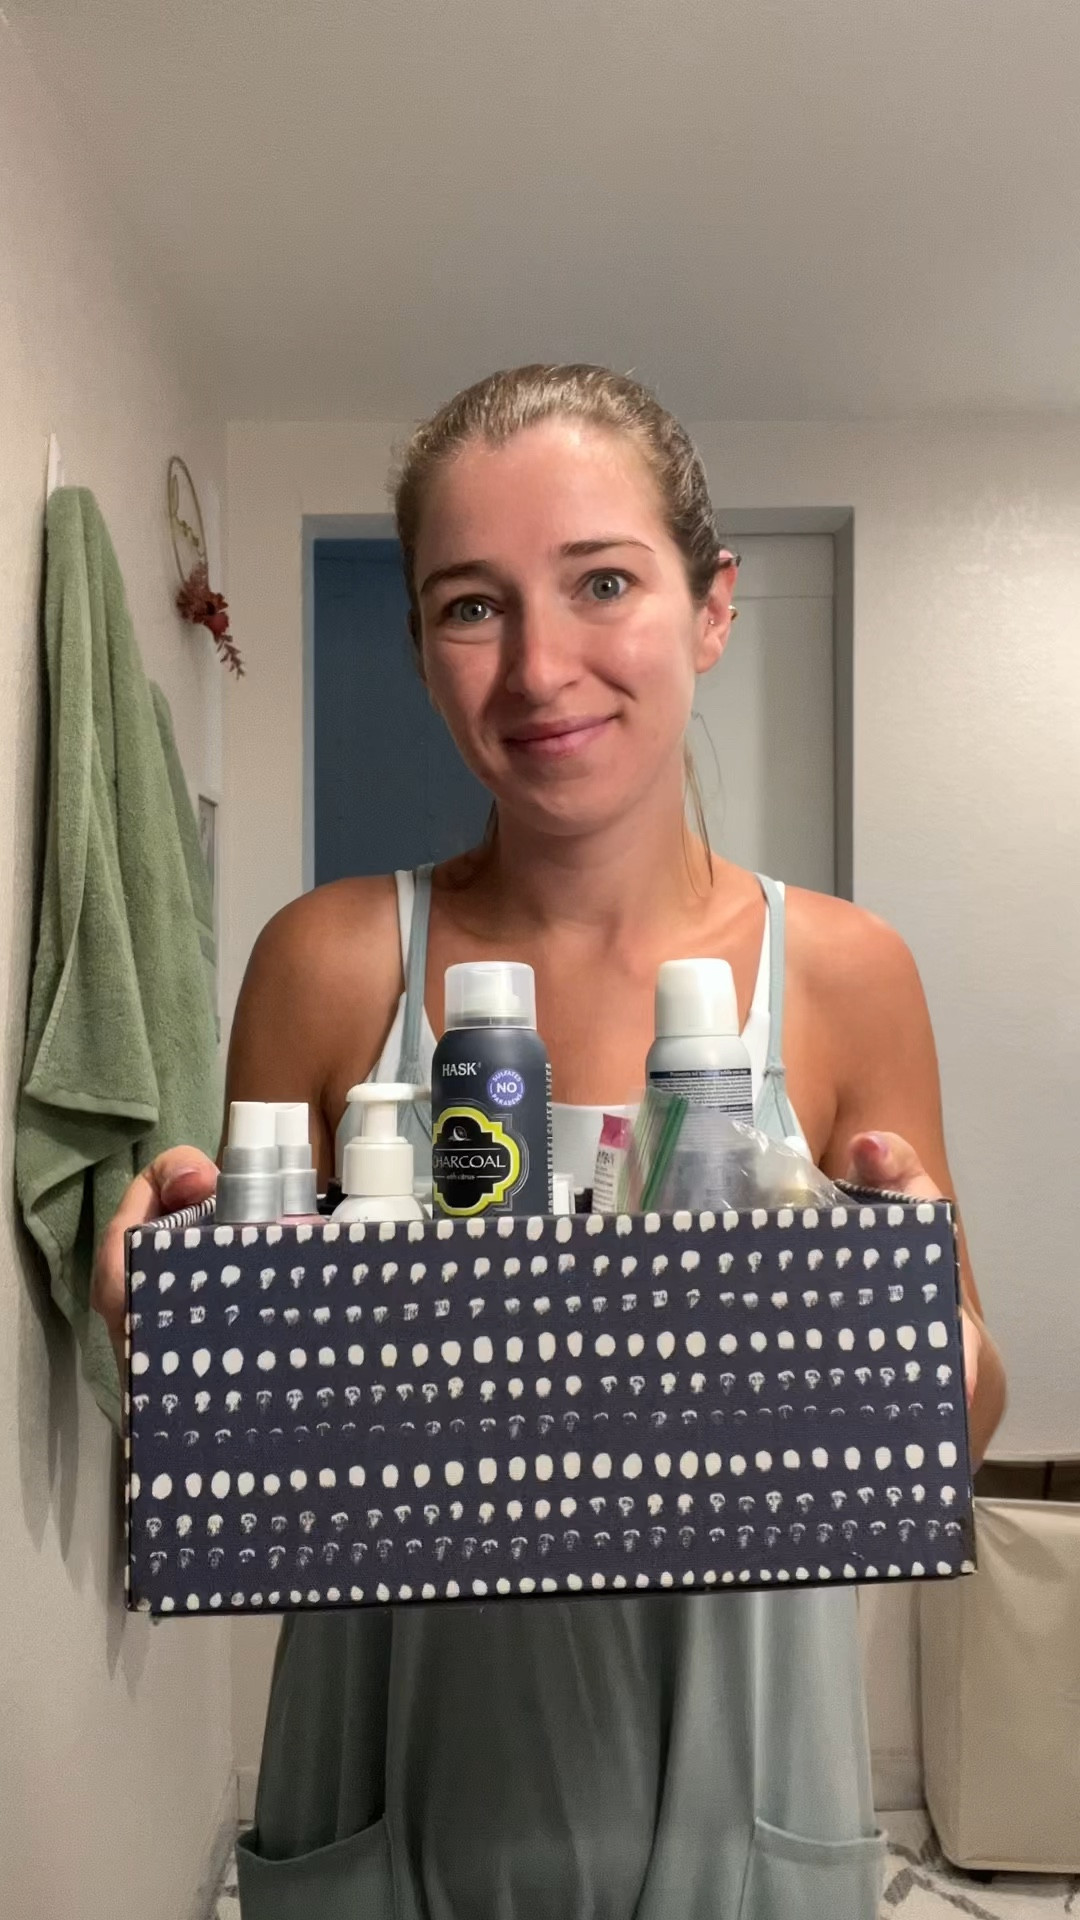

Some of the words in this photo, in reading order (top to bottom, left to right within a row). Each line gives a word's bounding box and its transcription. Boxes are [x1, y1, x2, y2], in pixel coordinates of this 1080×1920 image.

[442, 1062, 477, 1077] HASK
[492, 1069, 522, 1082] SULFATES
[496, 1082, 518, 1093] NO
